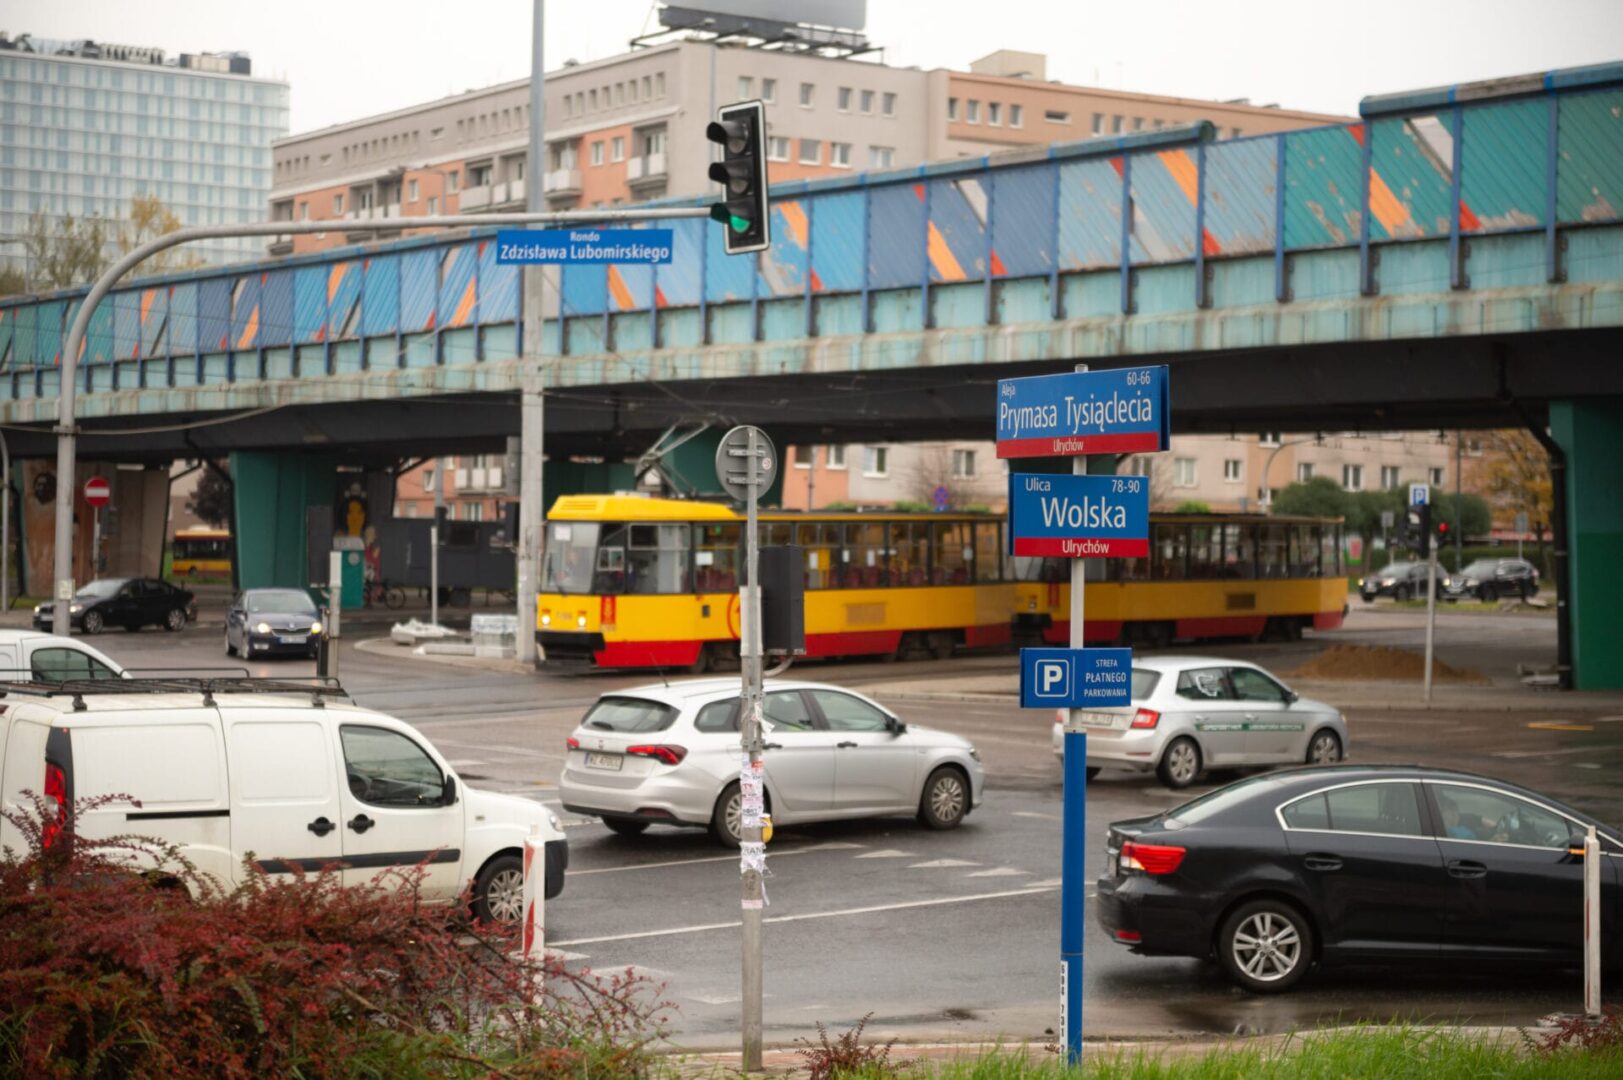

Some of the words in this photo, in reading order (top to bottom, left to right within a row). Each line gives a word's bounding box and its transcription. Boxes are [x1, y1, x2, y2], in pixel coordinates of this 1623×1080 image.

[570, 231, 600, 242] Rondo
[500, 244, 566, 260] Zdzisława
[570, 244, 669, 262] Lubomirskiego
[1127, 371, 1151, 386] 60-66
[1001, 383, 1016, 398] Aleja
[1000, 401, 1057, 438] Prymasa
[1064, 390, 1152, 434] Tysiąclecia
[1053, 439, 1084, 456] Ulrychów
[1025, 477, 1051, 492] Ulica
[1112, 479, 1140, 494] 78-90
[1041, 496, 1126, 529] Wolska
[1062, 540, 1109, 557] Ulrychów
[1095, 659, 1118, 668] STREFA
[1043, 664, 1063, 692] P
[1085, 672, 1127, 683] PŁATNEGO
[1083, 688, 1127, 698] PARKOWANIA
